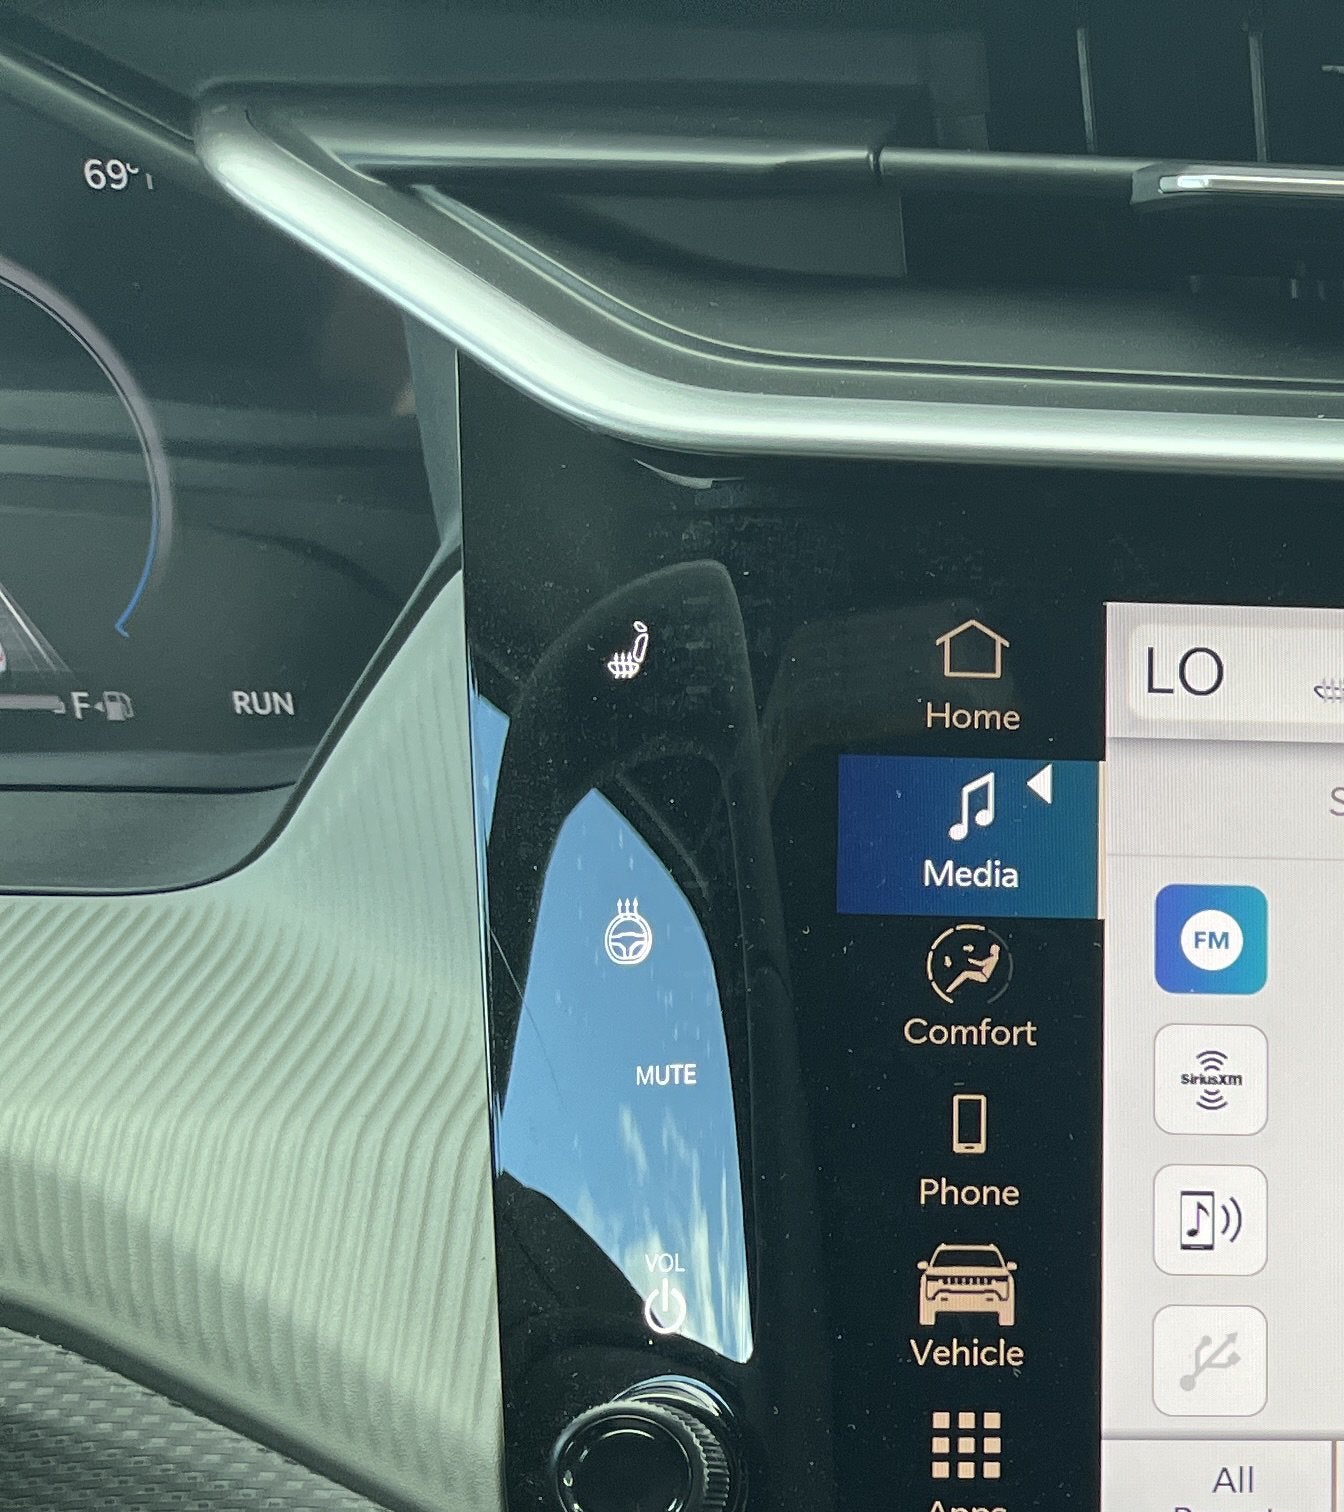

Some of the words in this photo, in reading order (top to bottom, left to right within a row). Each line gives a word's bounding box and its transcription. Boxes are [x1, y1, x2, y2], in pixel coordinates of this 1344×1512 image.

[1147, 646, 1224, 697] LO
[70, 691, 91, 719] F
[231, 690, 295, 715] RUN
[925, 699, 1020, 730] Home
[924, 859, 1019, 888] Media
[1194, 930, 1230, 950] FM
[903, 1017, 1037, 1047] Comfort
[635, 1063, 698, 1086] MUTE
[920, 1176, 1020, 1206] Phone
[645, 1252, 686, 1274] VOL
[909, 1337, 1024, 1367] Vehicle
[1212, 1465, 1254, 1494] All
